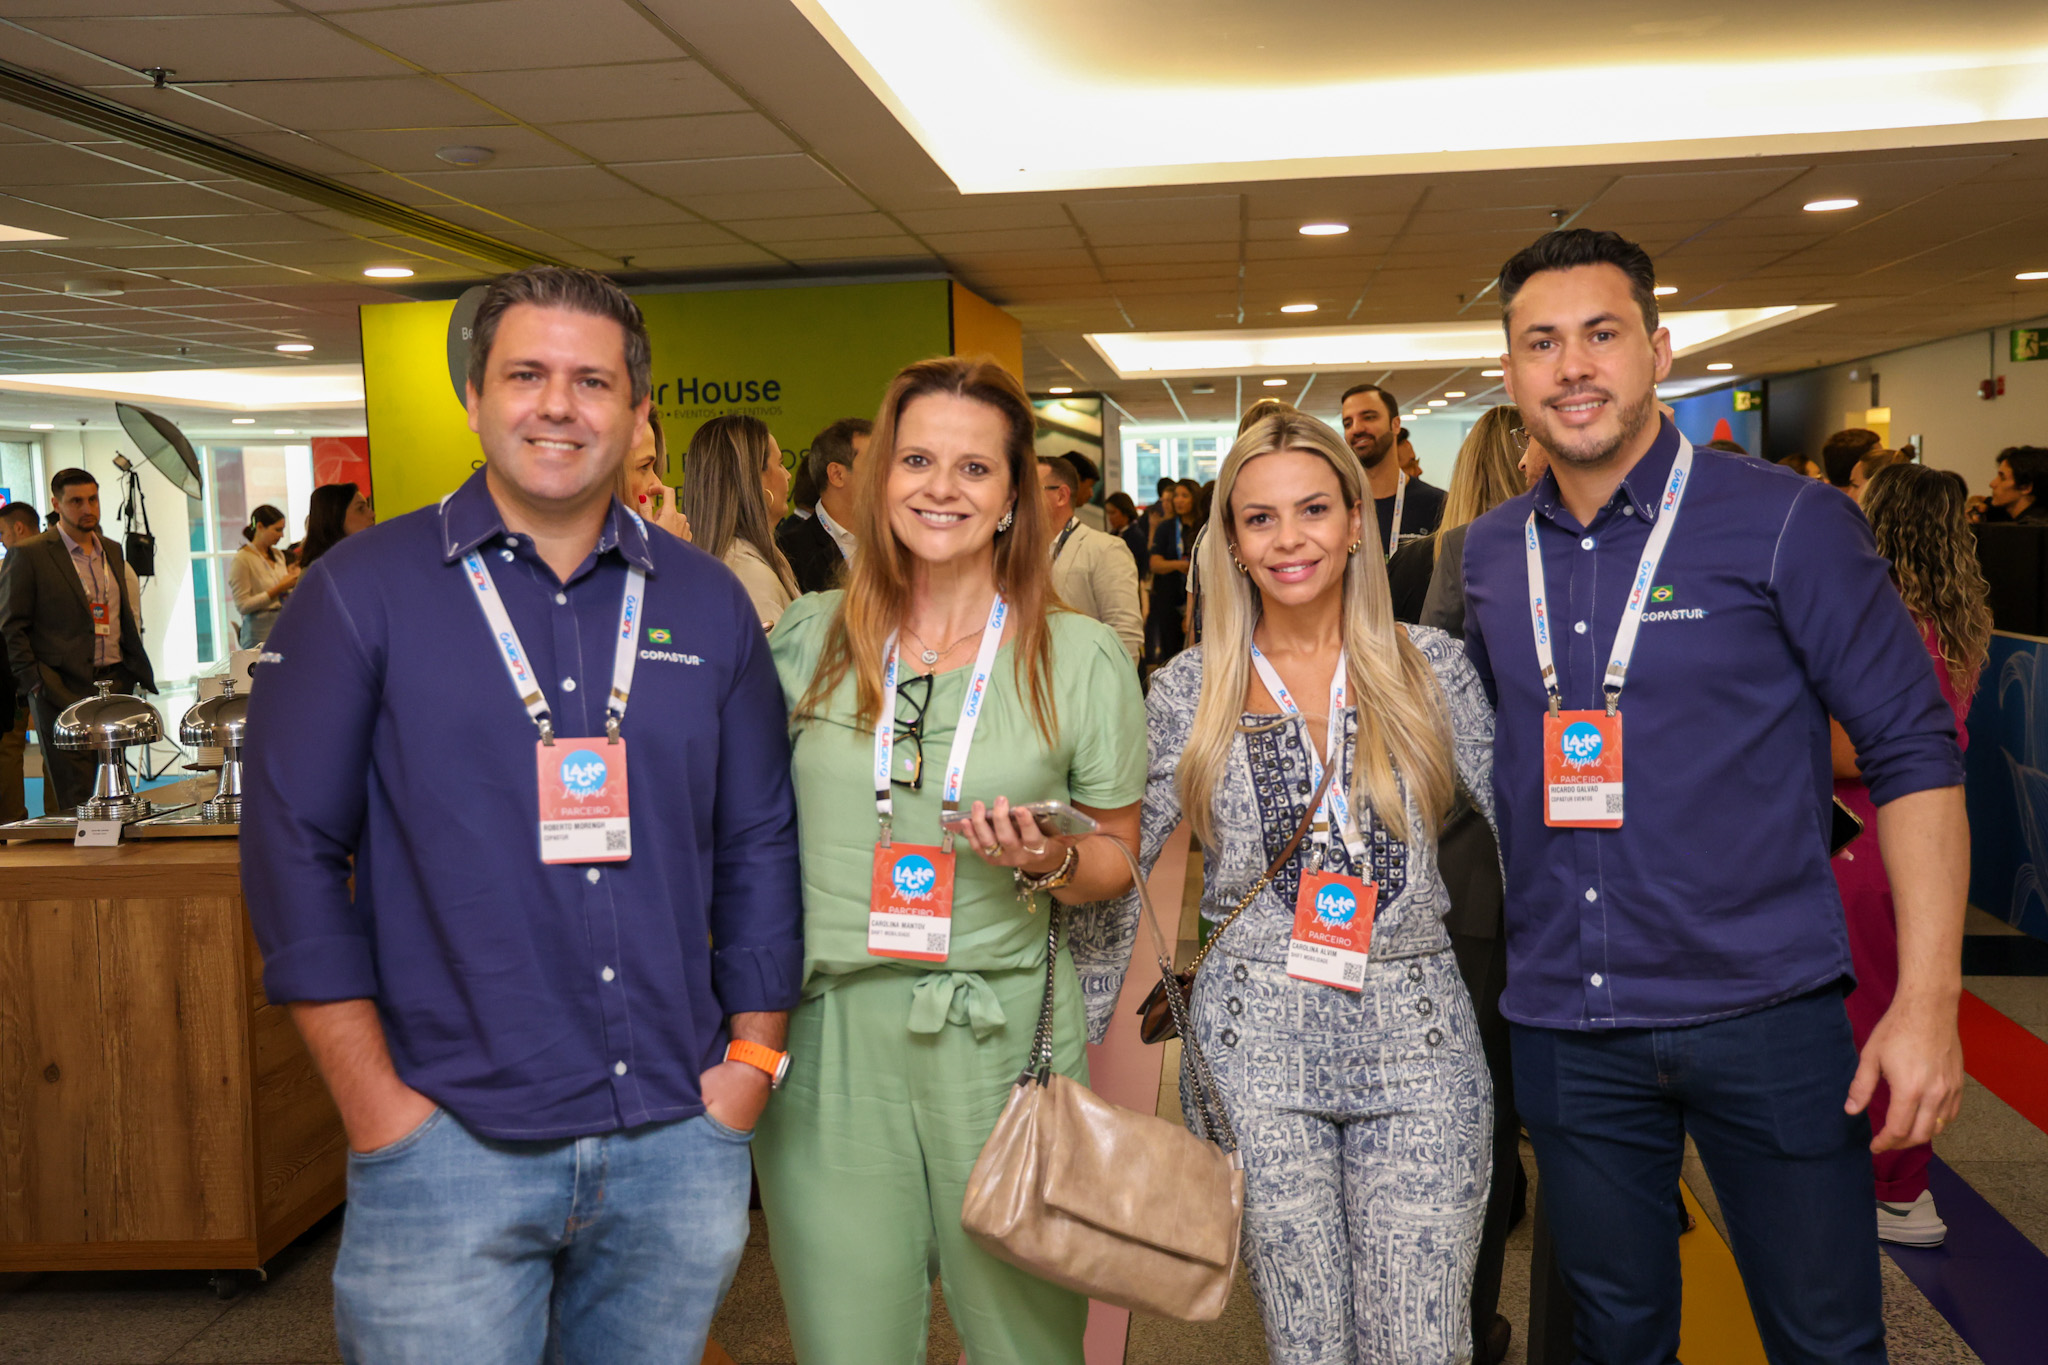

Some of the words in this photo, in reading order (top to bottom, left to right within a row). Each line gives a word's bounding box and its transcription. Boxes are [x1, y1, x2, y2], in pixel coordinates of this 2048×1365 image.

[677, 377, 781, 405] House
[674, 408, 717, 419] EVENTOS
[1640, 608, 1704, 623] COPASTUR
[640, 650, 700, 666] COPASTUR
[1560, 775, 1604, 784] PARCEIRO
[561, 805, 610, 816] PARCEIRO
[543, 823, 572, 831] ROBERTO
[888, 906, 935, 917] PARCEIRO
[871, 920, 899, 928] CAROLINA
[1308, 930, 1352, 947] PARCEIRO
[1292, 942, 1319, 953] CAROLINA
[1320, 948, 1337, 957] ALVIM
